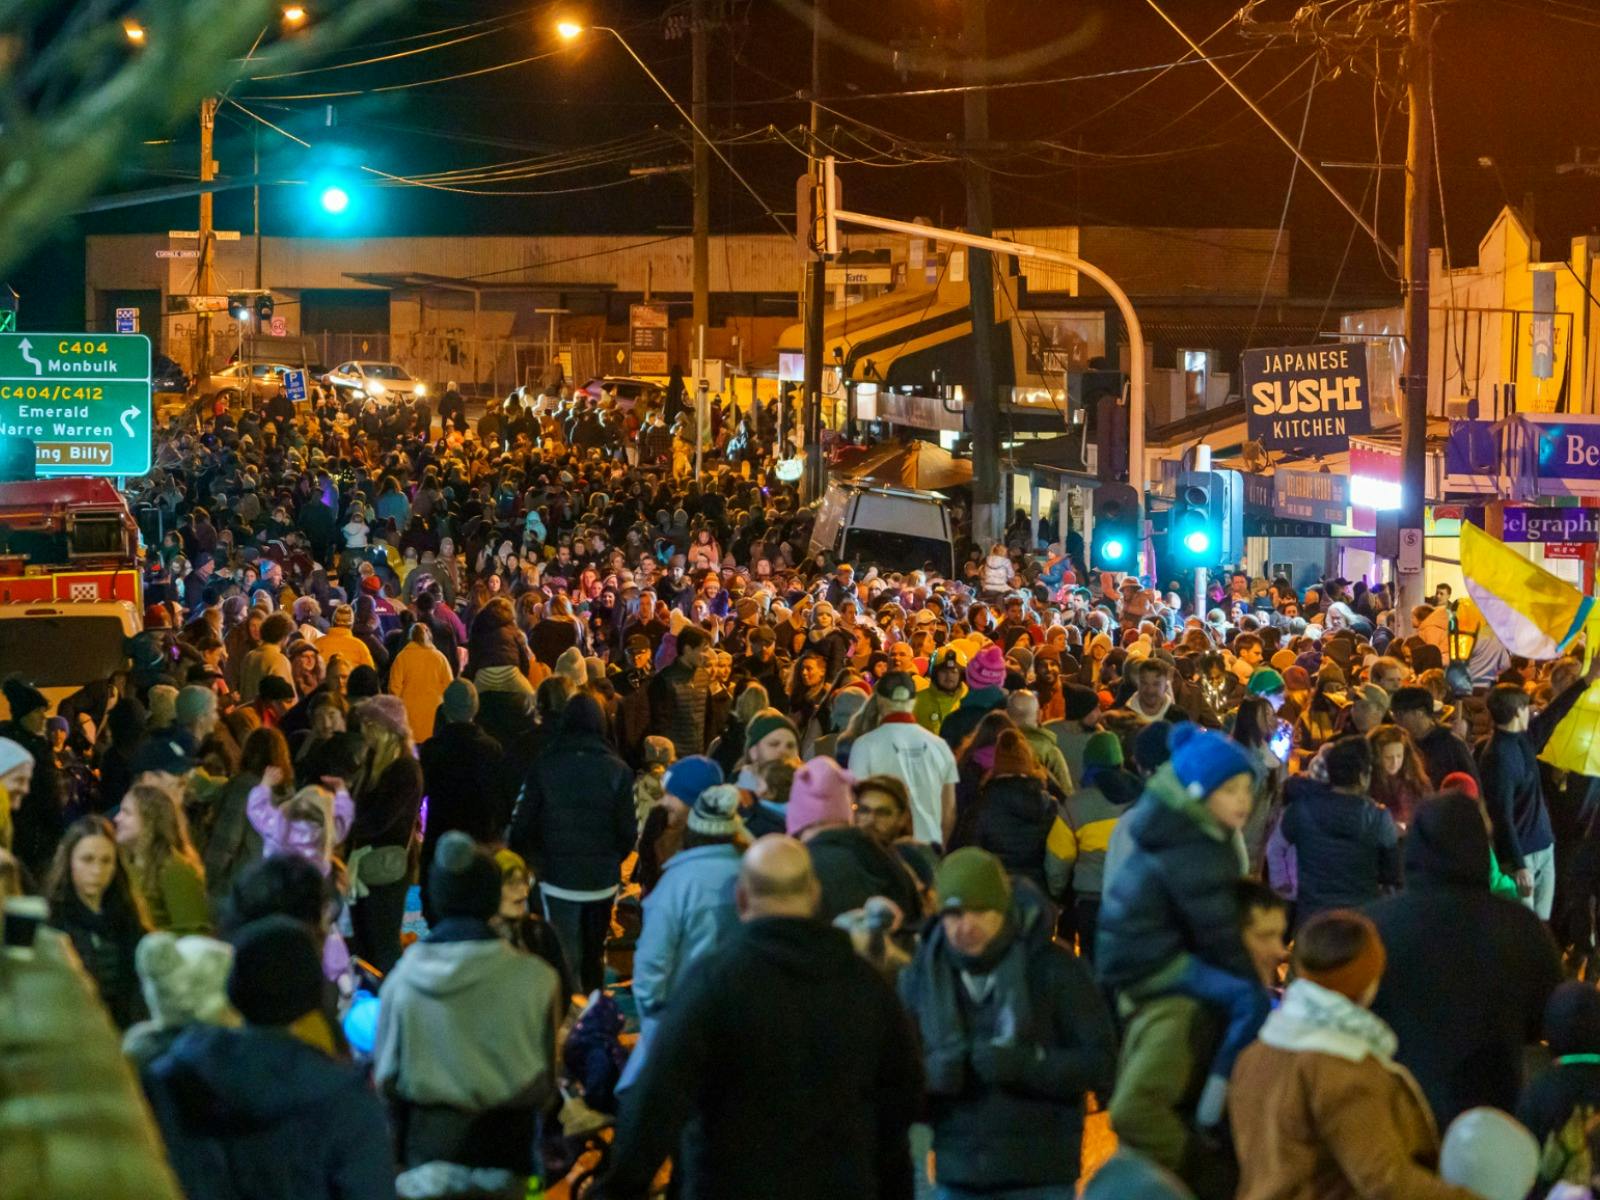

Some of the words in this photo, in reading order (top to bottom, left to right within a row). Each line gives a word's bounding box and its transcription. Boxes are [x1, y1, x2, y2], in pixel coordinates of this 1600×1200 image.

[58, 342, 108, 354] C404
[48, 360, 117, 372] Monbulk
[1262, 350, 1349, 374] JAPANESE
[1, 386, 103, 400] C404/C412
[1252, 376, 1362, 415] SUSHI
[19, 405, 89, 418] Emerald
[53, 424, 113, 436] Warren
[1273, 417, 1346, 439] KITCHEN
[36, 446, 61, 462] ing
[70, 447, 109, 462] Billy
